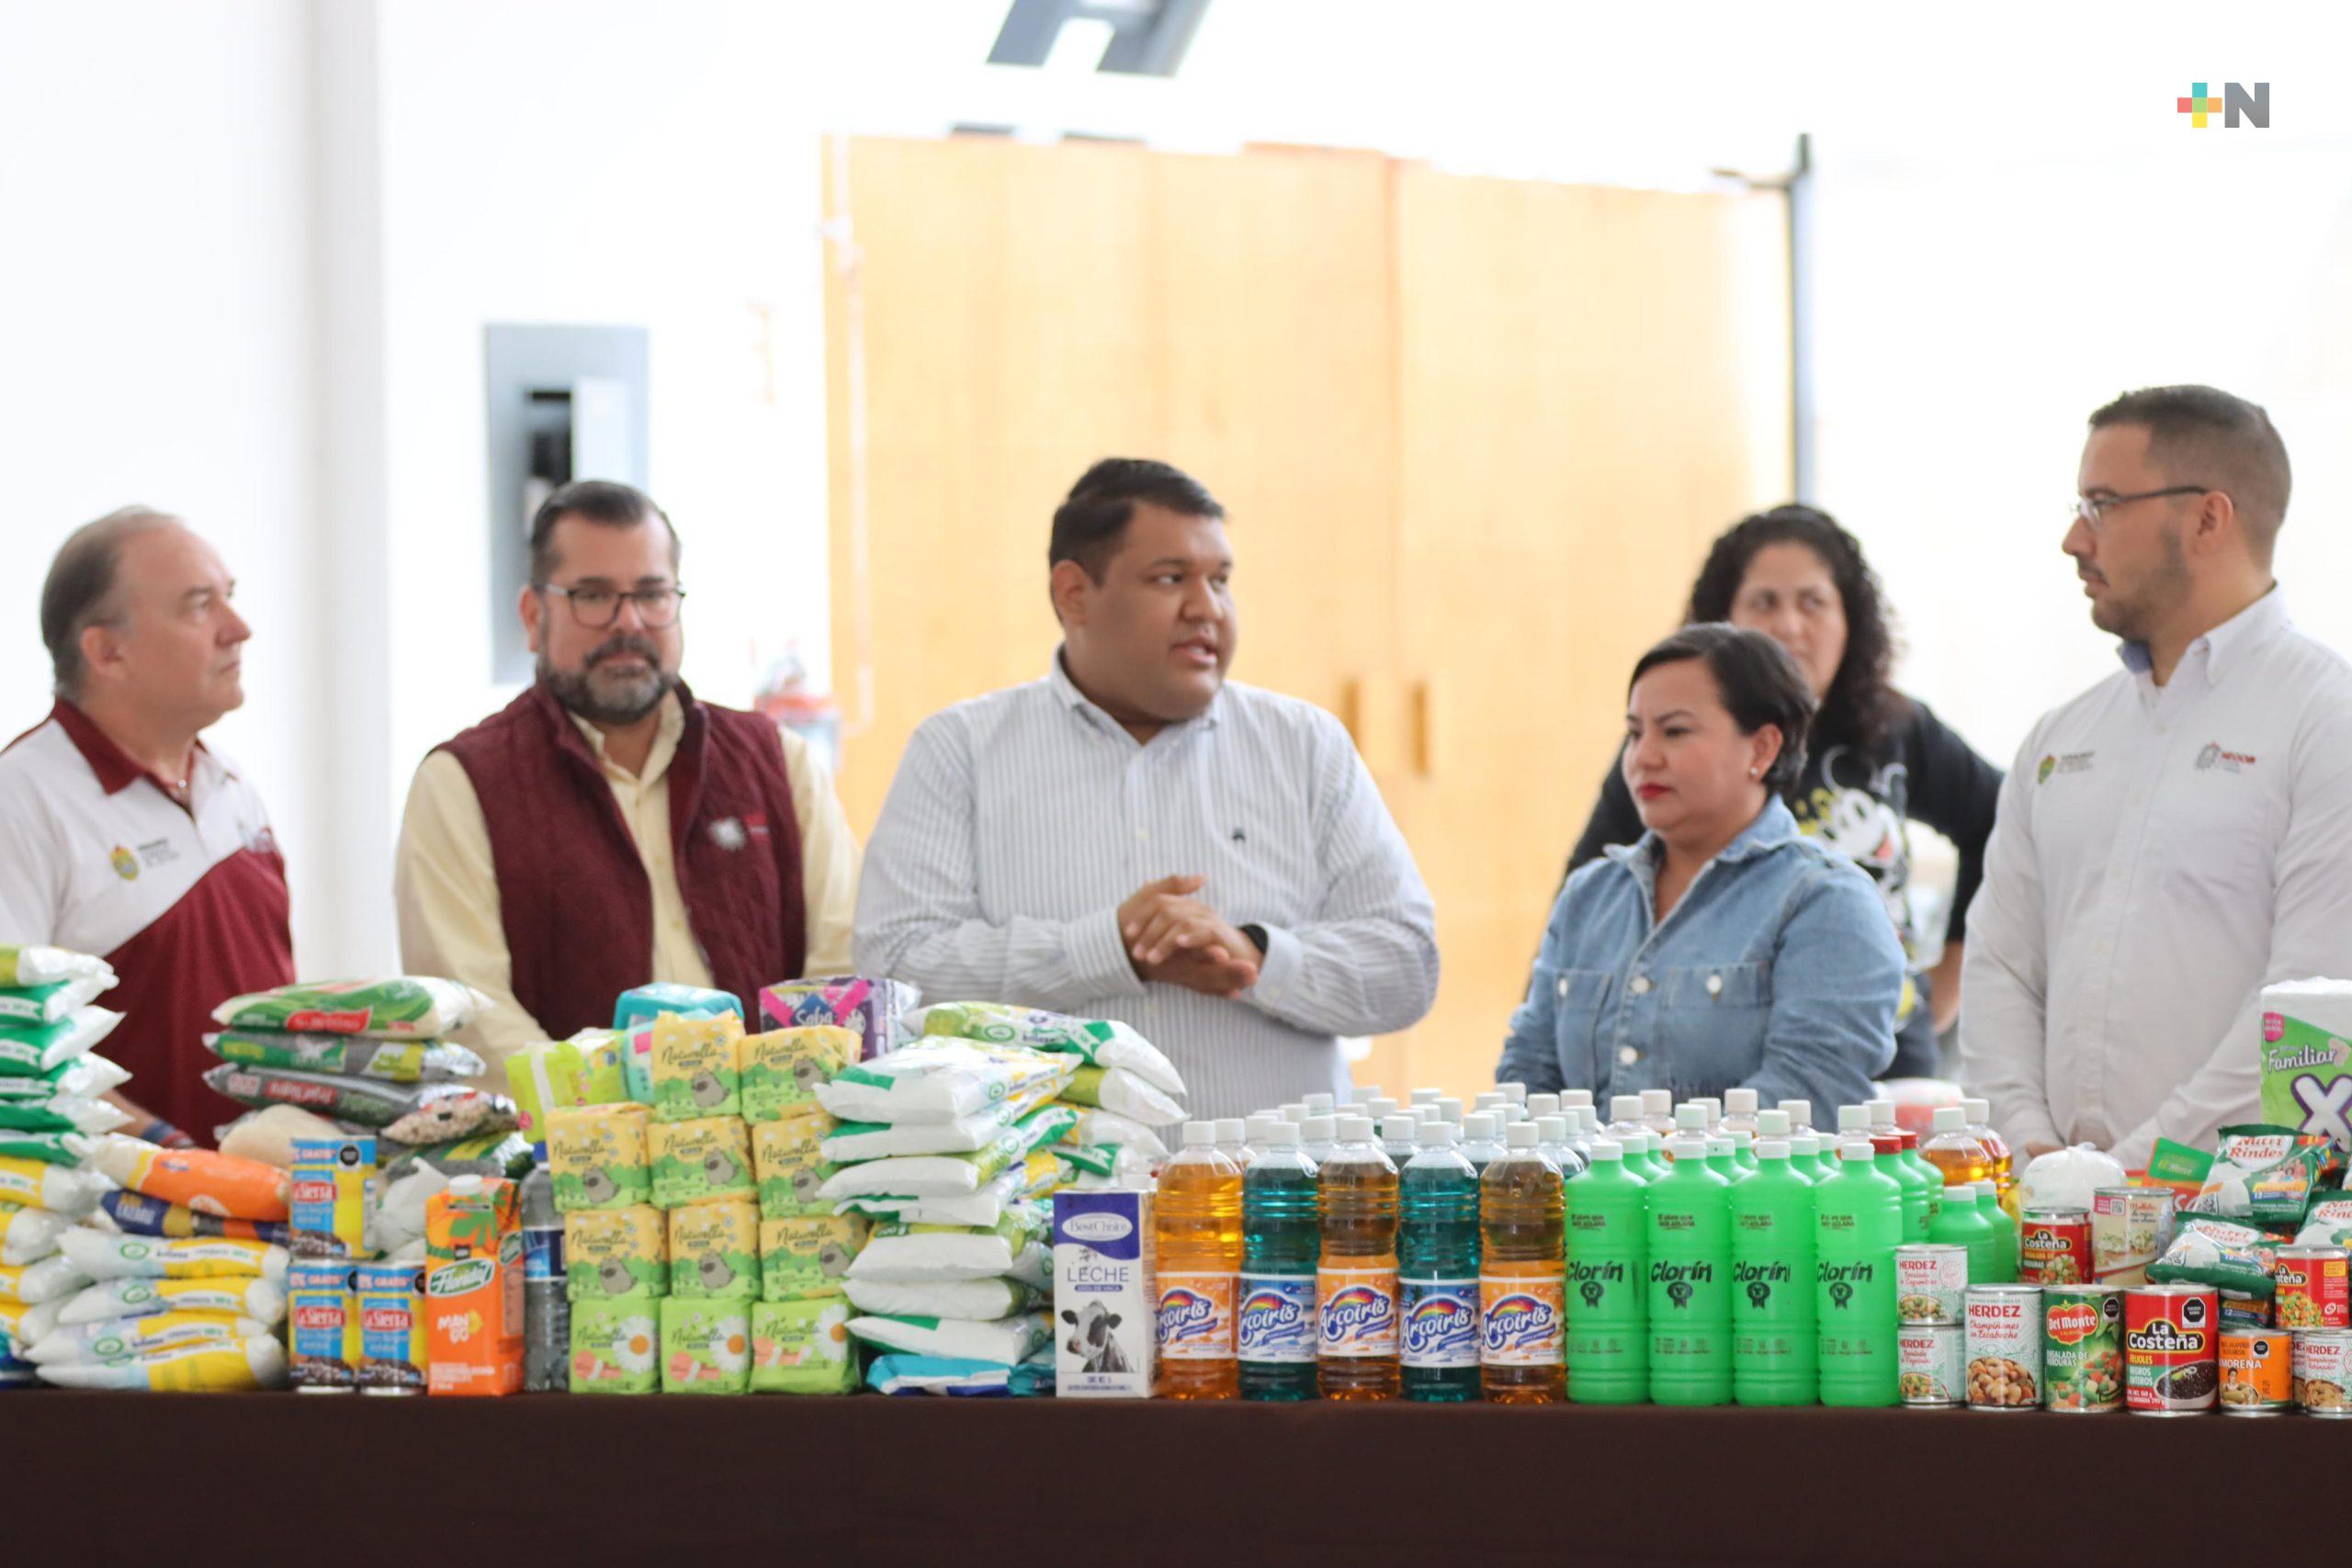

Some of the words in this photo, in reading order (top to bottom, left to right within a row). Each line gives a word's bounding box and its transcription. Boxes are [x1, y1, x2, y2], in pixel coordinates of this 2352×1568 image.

[796, 1006, 836, 1026] Saba
[662, 1043, 719, 1064] Naturella
[755, 1038, 808, 1060] Naturella
[2268, 1045, 2336, 1073] Familiar
[553, 1139, 605, 1157] Naturella
[664, 1130, 718, 1150] Naturella
[763, 1138, 820, 1160] Naturella
[2228, 1147, 2284, 1158] Rindes
[572, 1229, 625, 1247] Naturella
[674, 1223, 726, 1242] Naturella
[777, 1223, 833, 1243] Naturella
[2037, 1231, 2049, 1240] La
[2024, 1238, 2068, 1250] Costeña
[1567, 1260, 1623, 1282] Clorín
[1650, 1260, 1713, 1282] Clorín
[1734, 1260, 1788, 1282] Clorín
[1817, 1260, 1873, 1283] Clorín
[1899, 1260, 1937, 1269] HERDEZ
[1067, 1267, 1129, 1282] LECHE
[1320, 1296, 1389, 1335] Arcoiris
[1968, 1305, 2021, 1318] HERDEZ
[765, 1315, 816, 1338] Naturella
[1403, 1306, 1471, 1343] Arcoiris
[1481, 1304, 1551, 1341] Arcoiris
[2048, 1317, 2061, 1330] Del
[2062, 1314, 2096, 1329] Monte
[2152, 1322, 2168, 1334] La
[1900, 1339, 1934, 1348] HERDEZ
[2129, 1334, 2199, 1350] Costeña
[2306, 1346, 2340, 1355] HERDEZ
[2129, 1354, 2154, 1364] FRIJOLES
